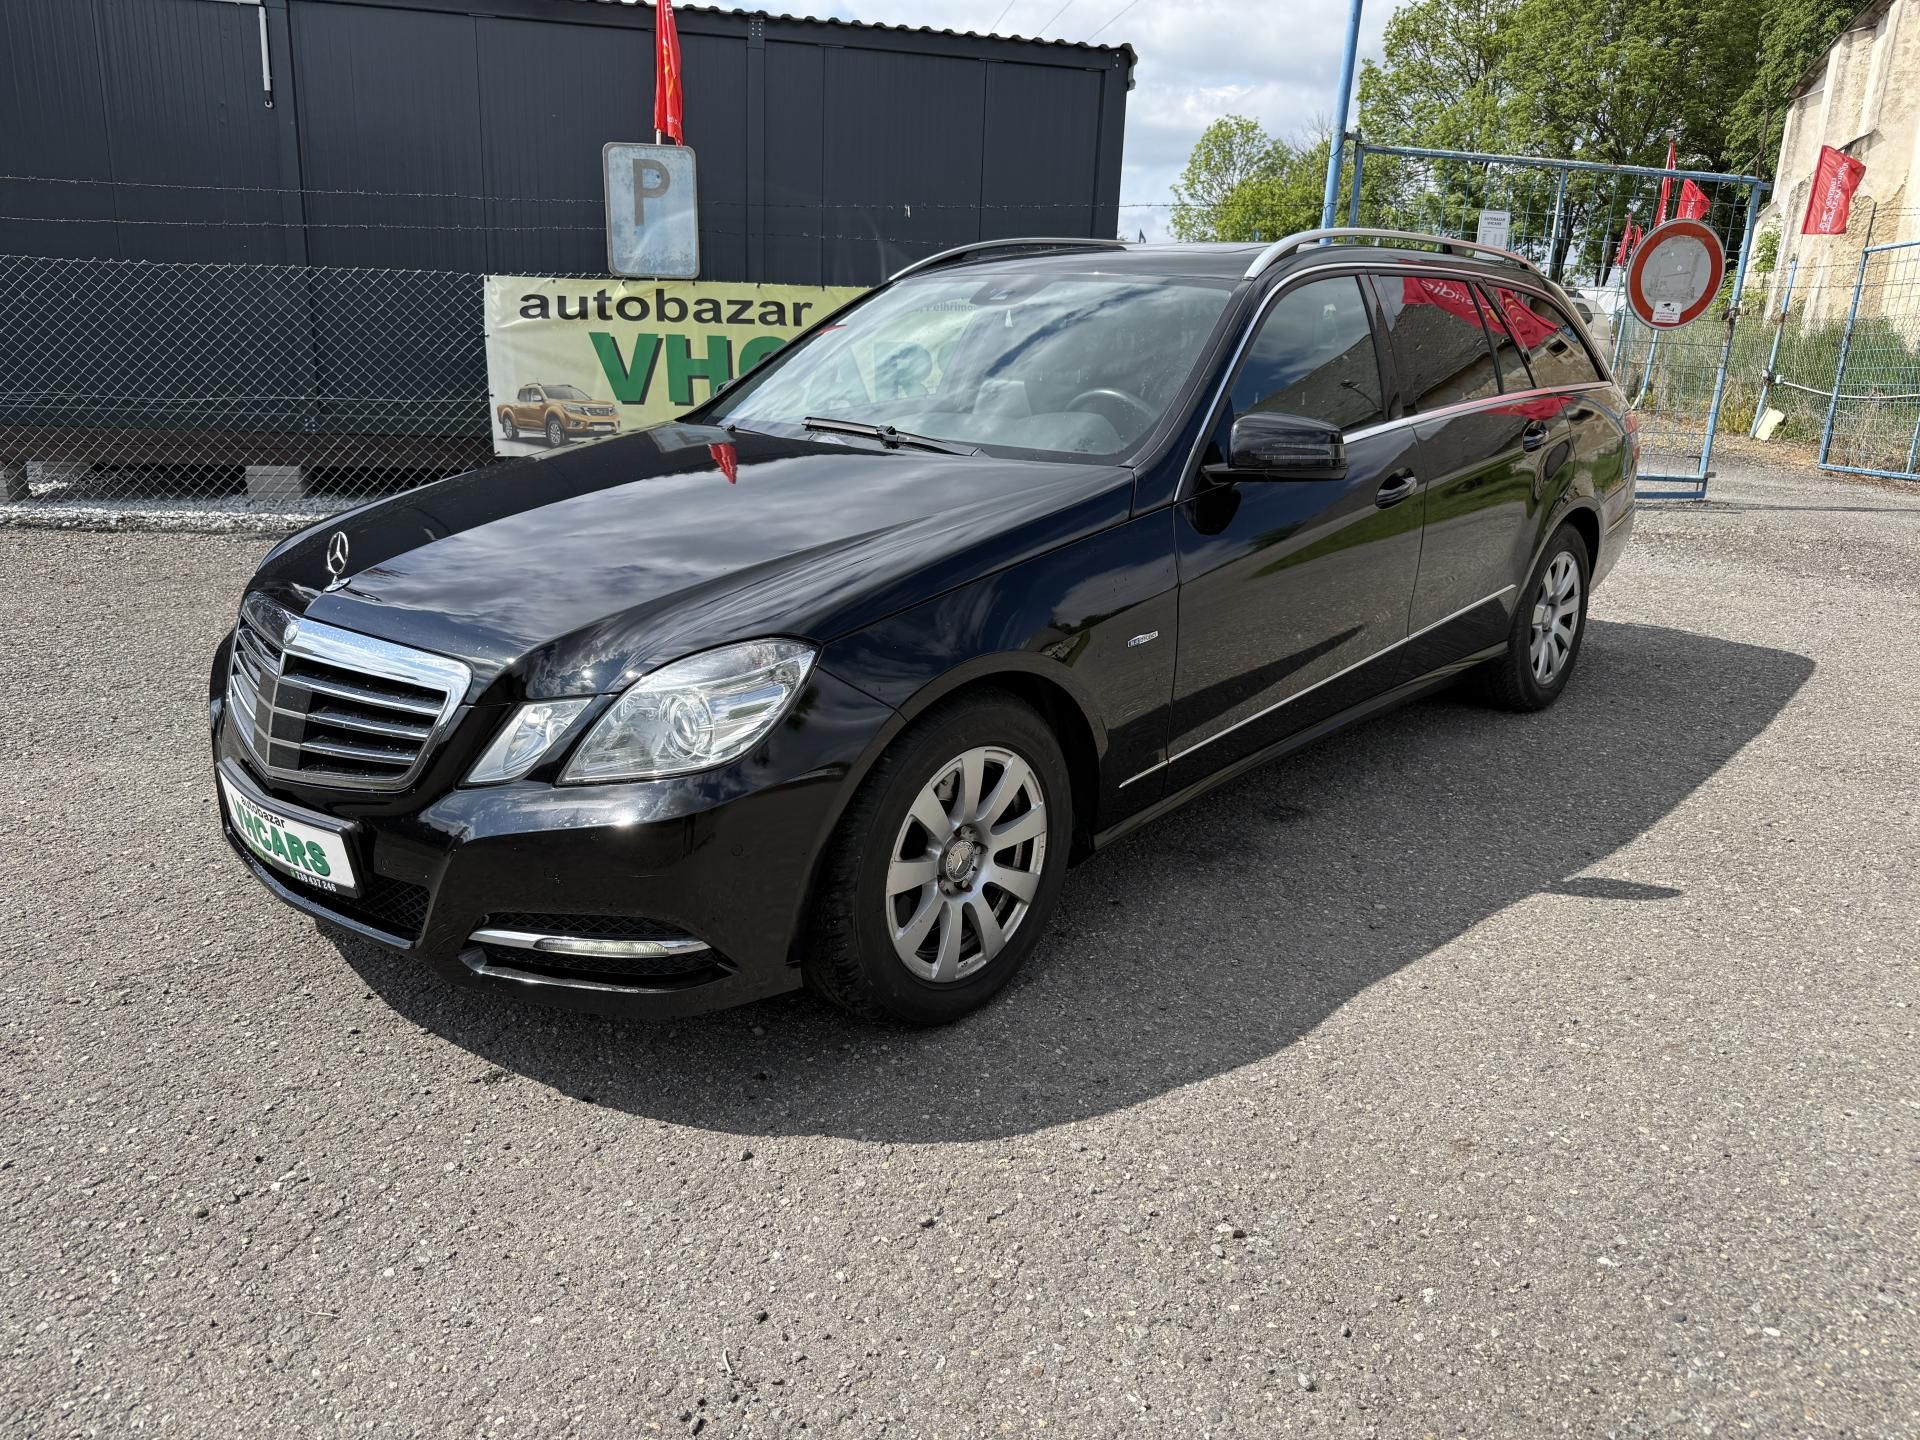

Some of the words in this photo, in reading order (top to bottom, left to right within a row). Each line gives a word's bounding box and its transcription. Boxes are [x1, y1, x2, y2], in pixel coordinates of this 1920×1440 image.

[632, 158, 671, 226] P
[519, 288, 812, 327] autobazar
[230, 792, 331, 877] VHCARS
[240, 796, 285, 828] autobazar
